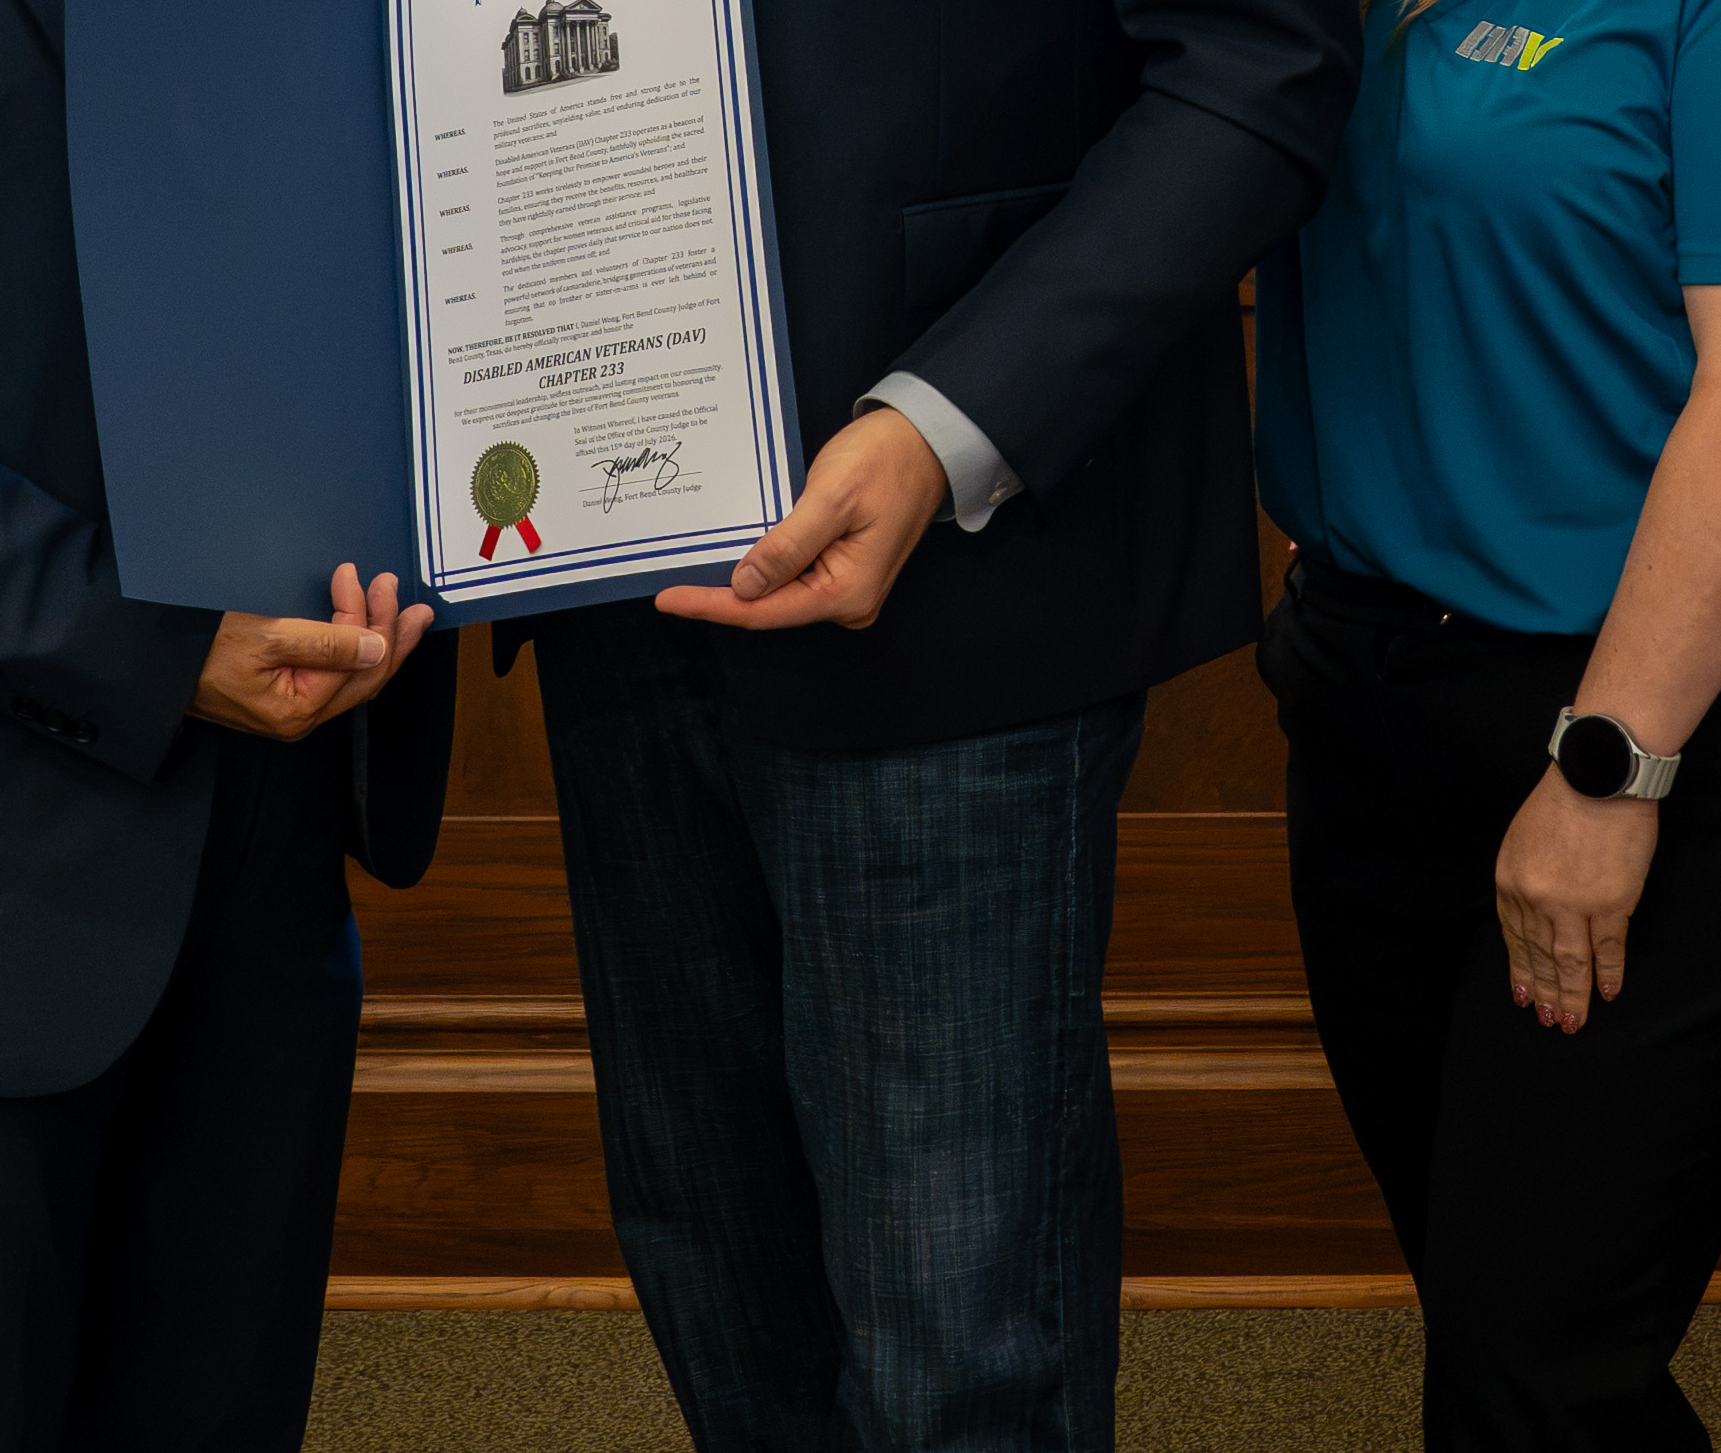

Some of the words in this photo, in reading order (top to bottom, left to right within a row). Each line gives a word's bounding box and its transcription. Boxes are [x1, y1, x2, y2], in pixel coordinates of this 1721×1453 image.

[1455, 20, 1565, 71] DAV
[463, 361, 523, 384] DISABLED
[525, 348, 591, 372] AMERICAN
[595, 335, 663, 358] VETERANS
[666, 327, 706, 349] (DAV)
[539, 367, 597, 389] CHAPTER
[600, 361, 625, 378] 233
